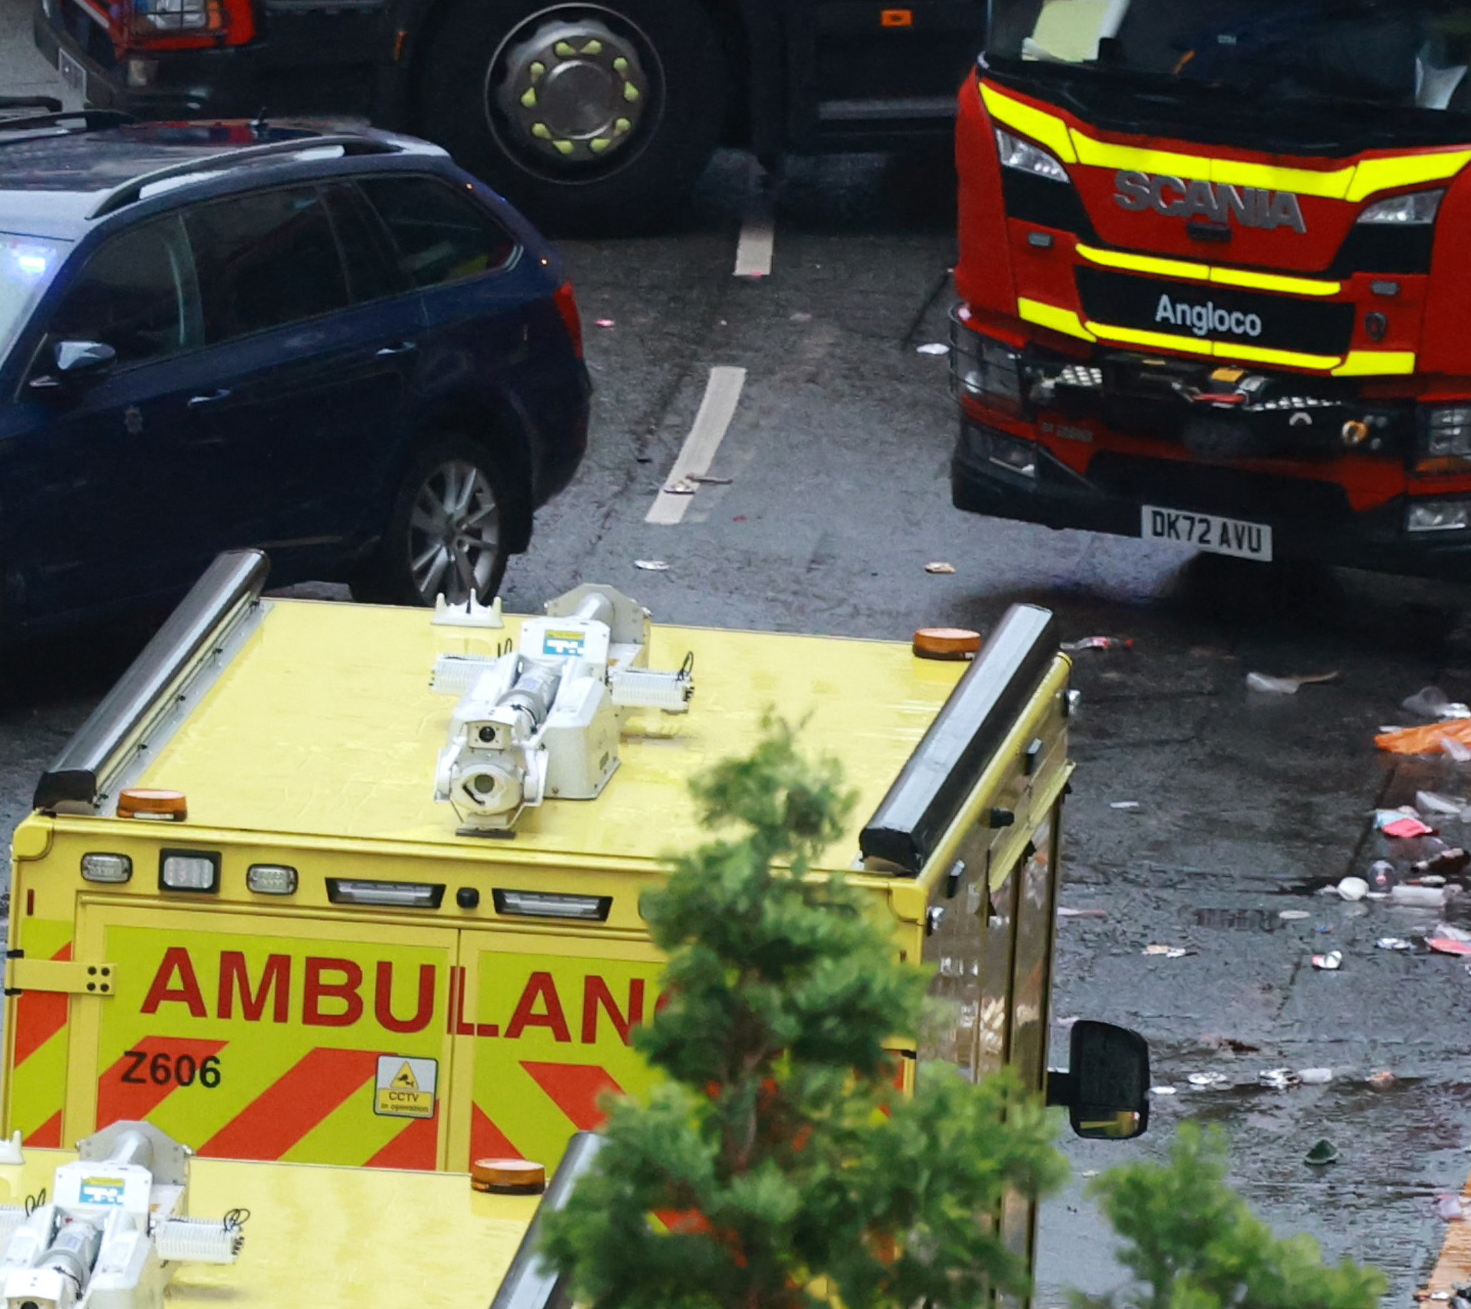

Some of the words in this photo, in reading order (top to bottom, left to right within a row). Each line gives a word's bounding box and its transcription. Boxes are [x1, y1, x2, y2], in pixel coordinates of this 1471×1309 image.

[1113, 170, 1306, 233] SCANIA
[1155, 293, 1262, 337] Angloco
[1152, 510, 1211, 544] DK72
[1219, 522, 1262, 553] AVU
[140, 947, 659, 1046] AMBULAN
[121, 1051, 221, 1088] Z606
[389, 1092, 419, 1102] CCTV
[390, 1103, 429, 1113] operation
